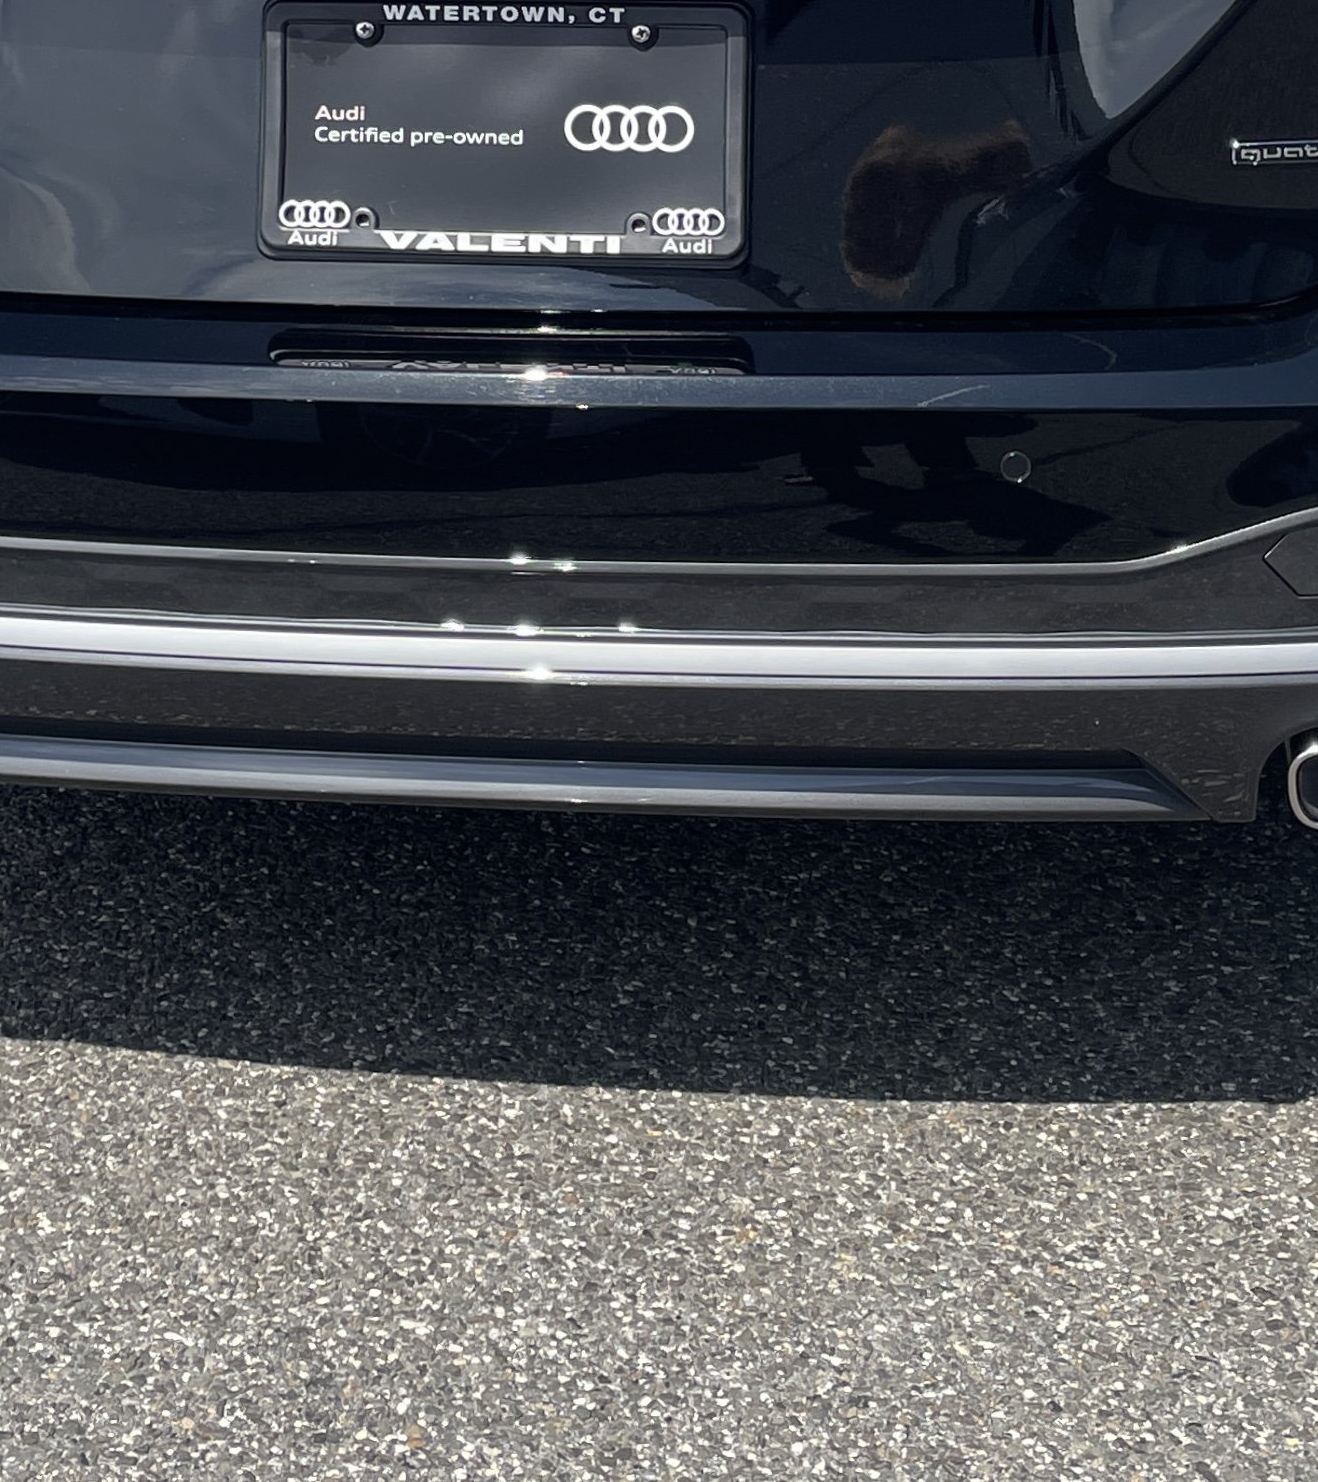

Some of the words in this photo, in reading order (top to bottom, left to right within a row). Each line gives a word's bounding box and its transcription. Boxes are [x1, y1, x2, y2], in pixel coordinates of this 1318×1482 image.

[382, 4, 576, 24] WATERTOWN,
[588, 6, 626, 24] CT
[314, 104, 366, 121] Audi
[314, 125, 405, 144] Certified
[410, 128, 524, 147] pre-owned
[287, 230, 338, 246] Audi
[378, 231, 621, 254] VALENTI
[661, 237, 713, 255] Audi
